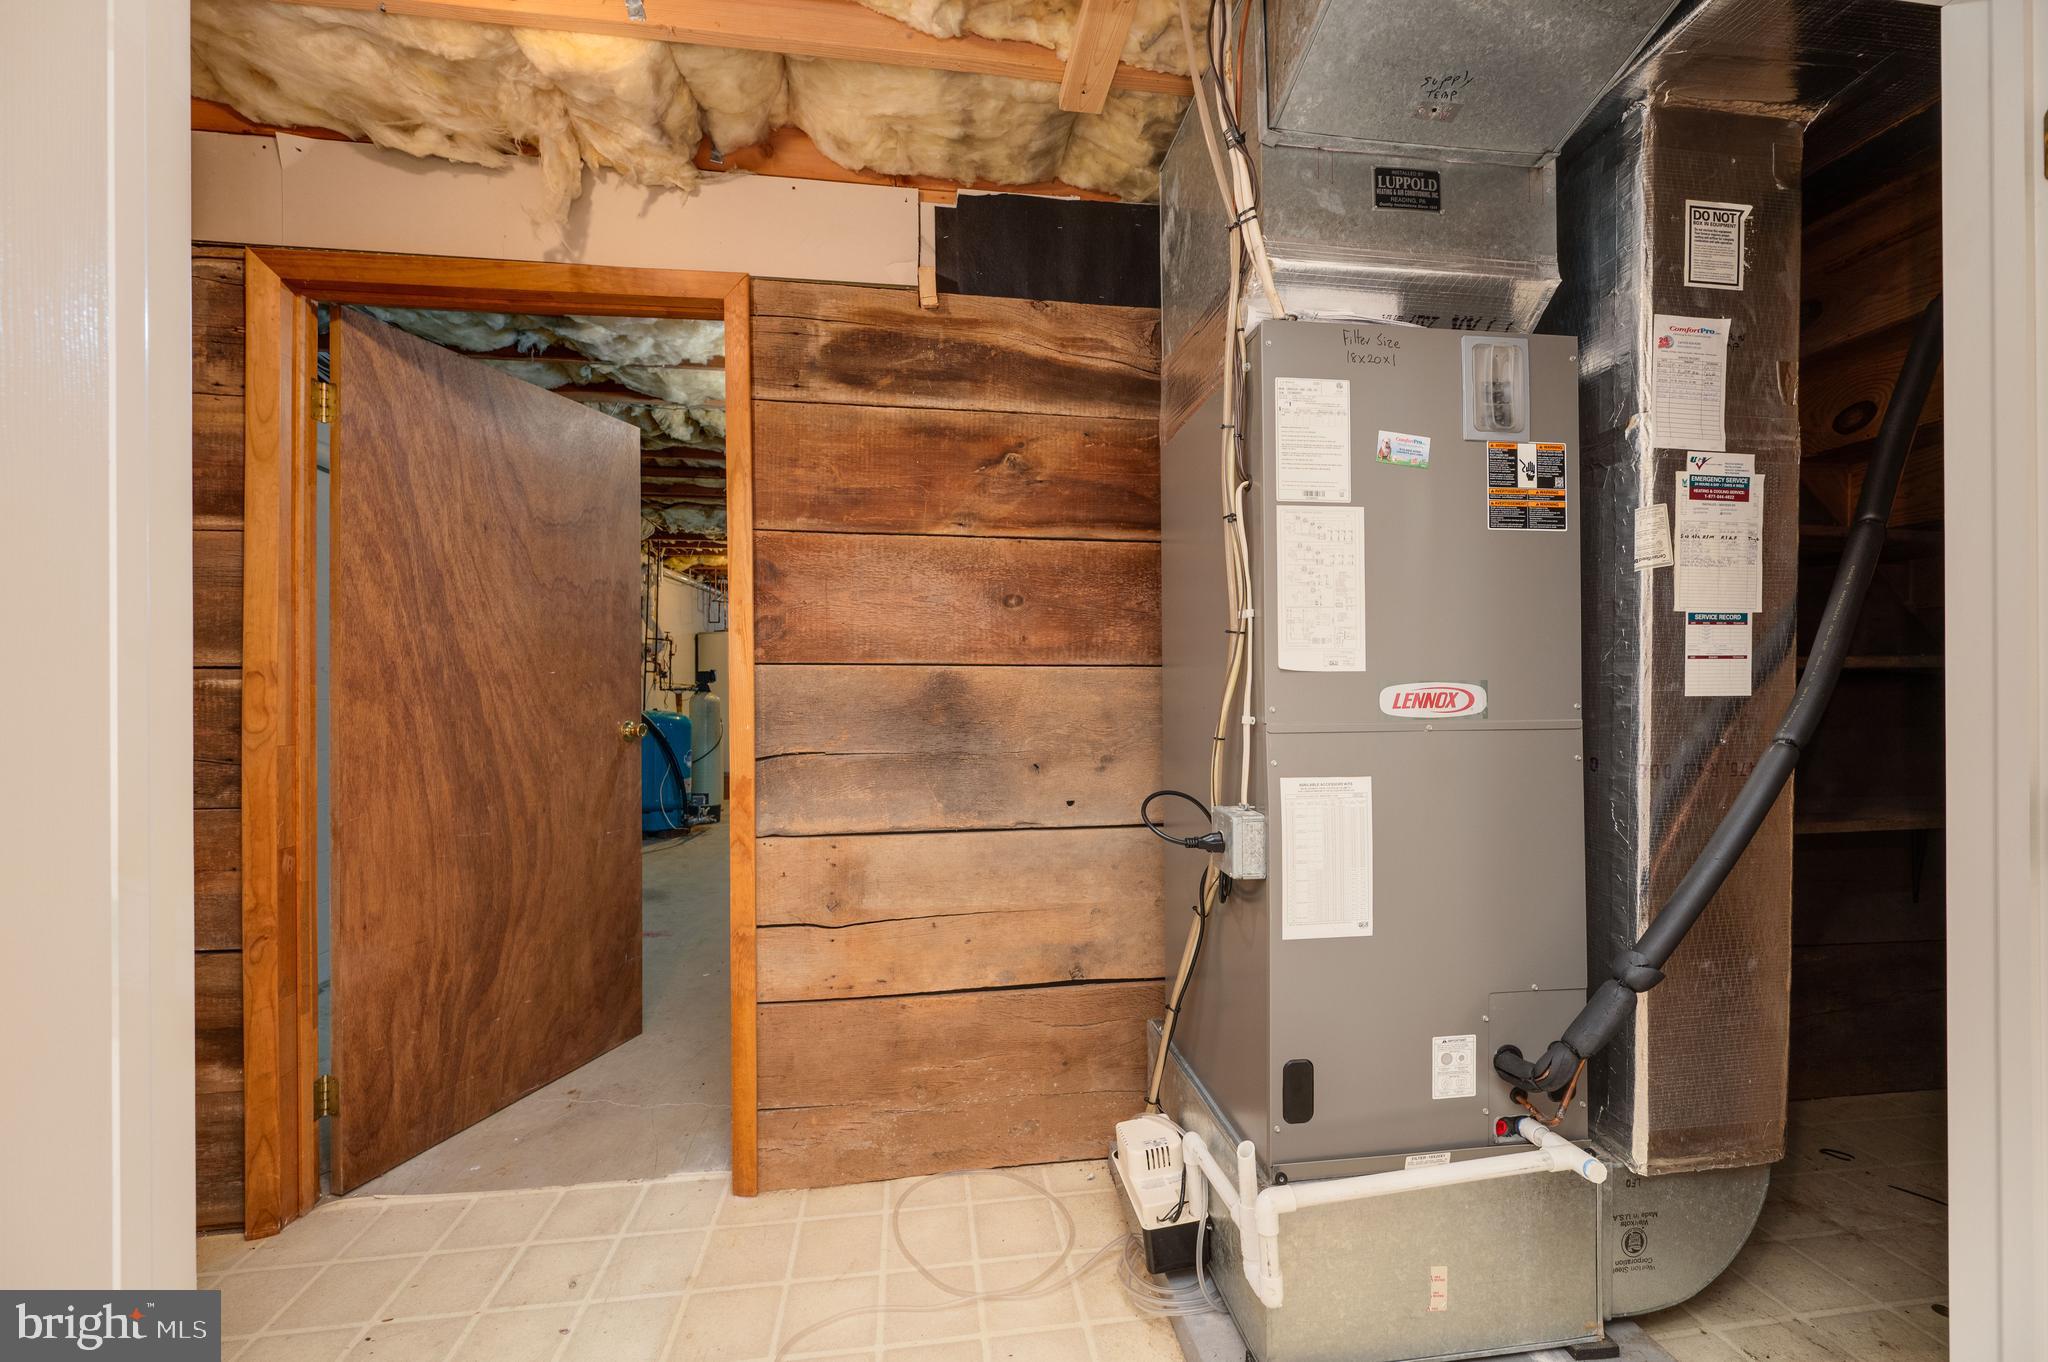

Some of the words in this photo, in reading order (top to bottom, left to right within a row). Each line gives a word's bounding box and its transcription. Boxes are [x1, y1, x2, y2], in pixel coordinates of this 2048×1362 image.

[1377, 175, 1438, 191] LUPPOLD
[1693, 209, 1710, 221] DO
[1713, 211, 1737, 223] NOT
[1669, 325, 1715, 335] ComfortPro
[1343, 328, 1371, 346] Filter
[1377, 333, 1401, 349] Size
[1691, 475, 1725, 483] EMERGENCY
[1392, 691, 1459, 710] LENNOX
[1614, 1257, 1653, 1266] Corporation
[1612, 1266, 1629, 1274] Steel
